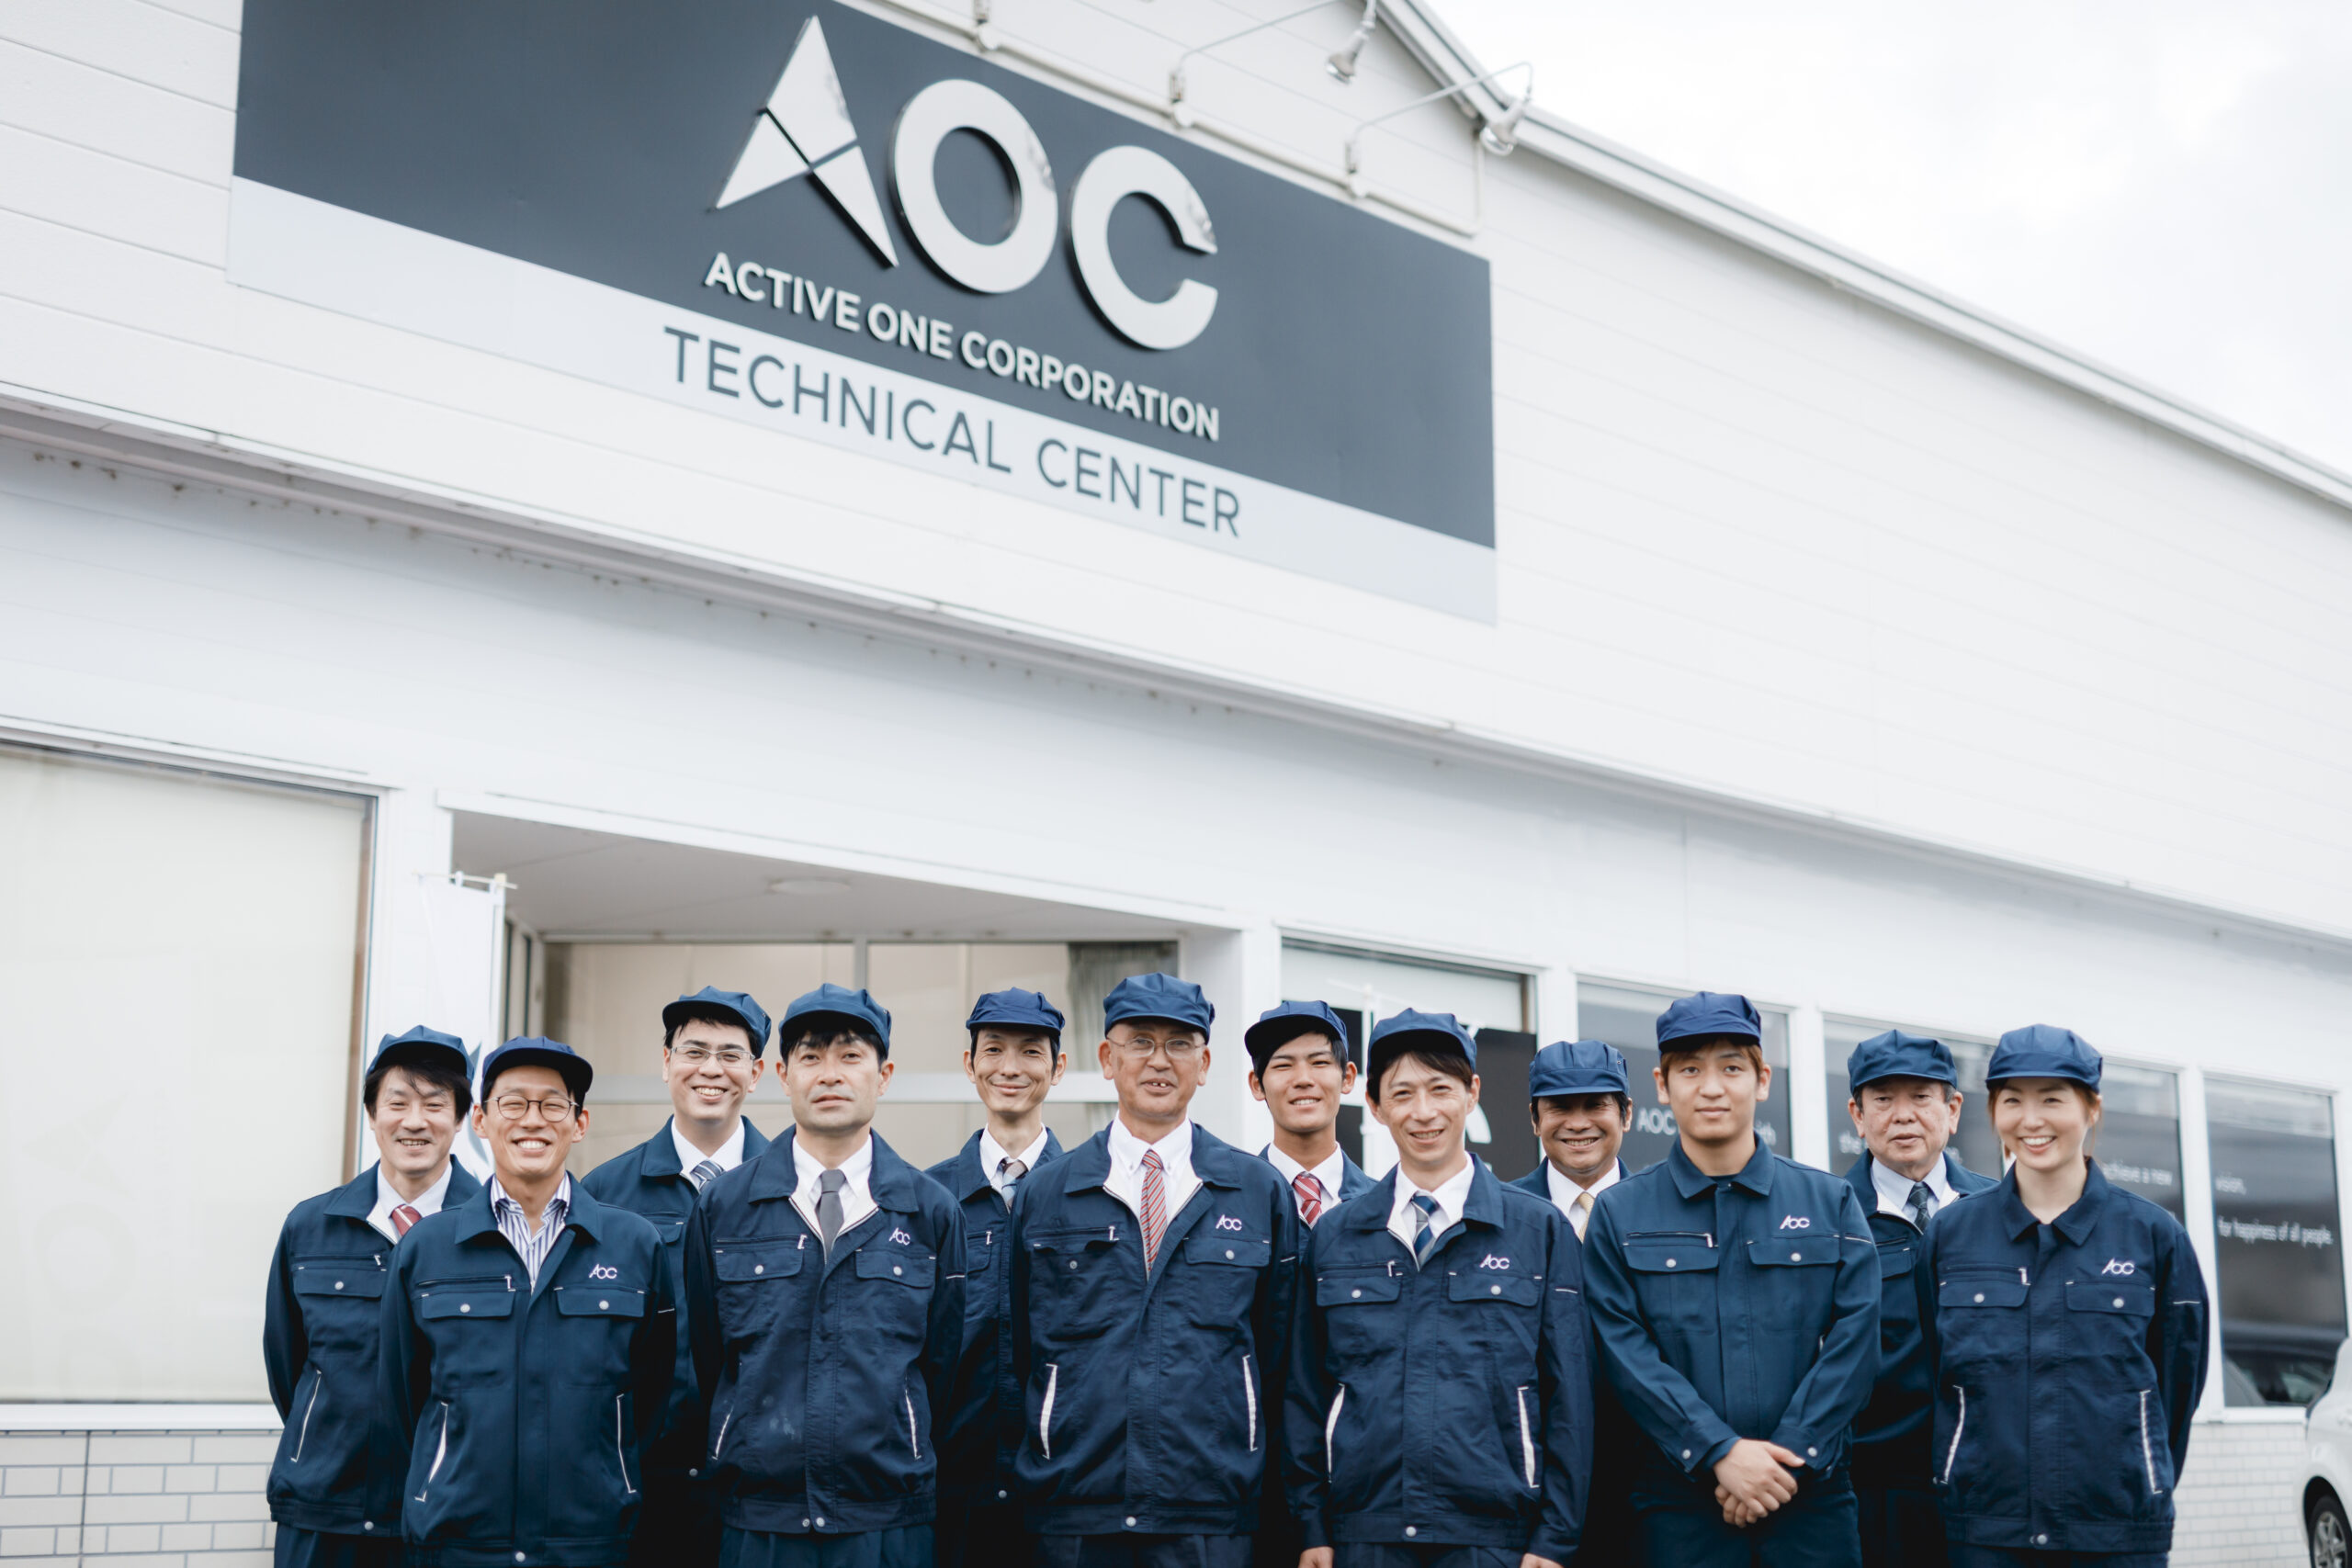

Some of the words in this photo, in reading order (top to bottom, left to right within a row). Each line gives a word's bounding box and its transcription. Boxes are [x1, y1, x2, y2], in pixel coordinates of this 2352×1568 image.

[715, 15, 1218, 351] AOC
[704, 252, 861, 333] ACTIVE
[866, 302, 954, 360] ONE
[961, 331, 1220, 442] CORPORATION
[664, 326, 1012, 474] TECHNICAL
[1037, 438, 1239, 538] CENTER
[1636, 1107, 1677, 1136] AOC
[1215, 1213, 1242, 1231] AOC
[1779, 1214, 1810, 1230] AOC
[2233, 1217, 2277, 1244] happiness
[888, 1227, 910, 1246] AOC
[1479, 1253, 1510, 1269] AOC
[2101, 1258, 2135, 1275] AOC
[588, 1263, 617, 1280] AOC
